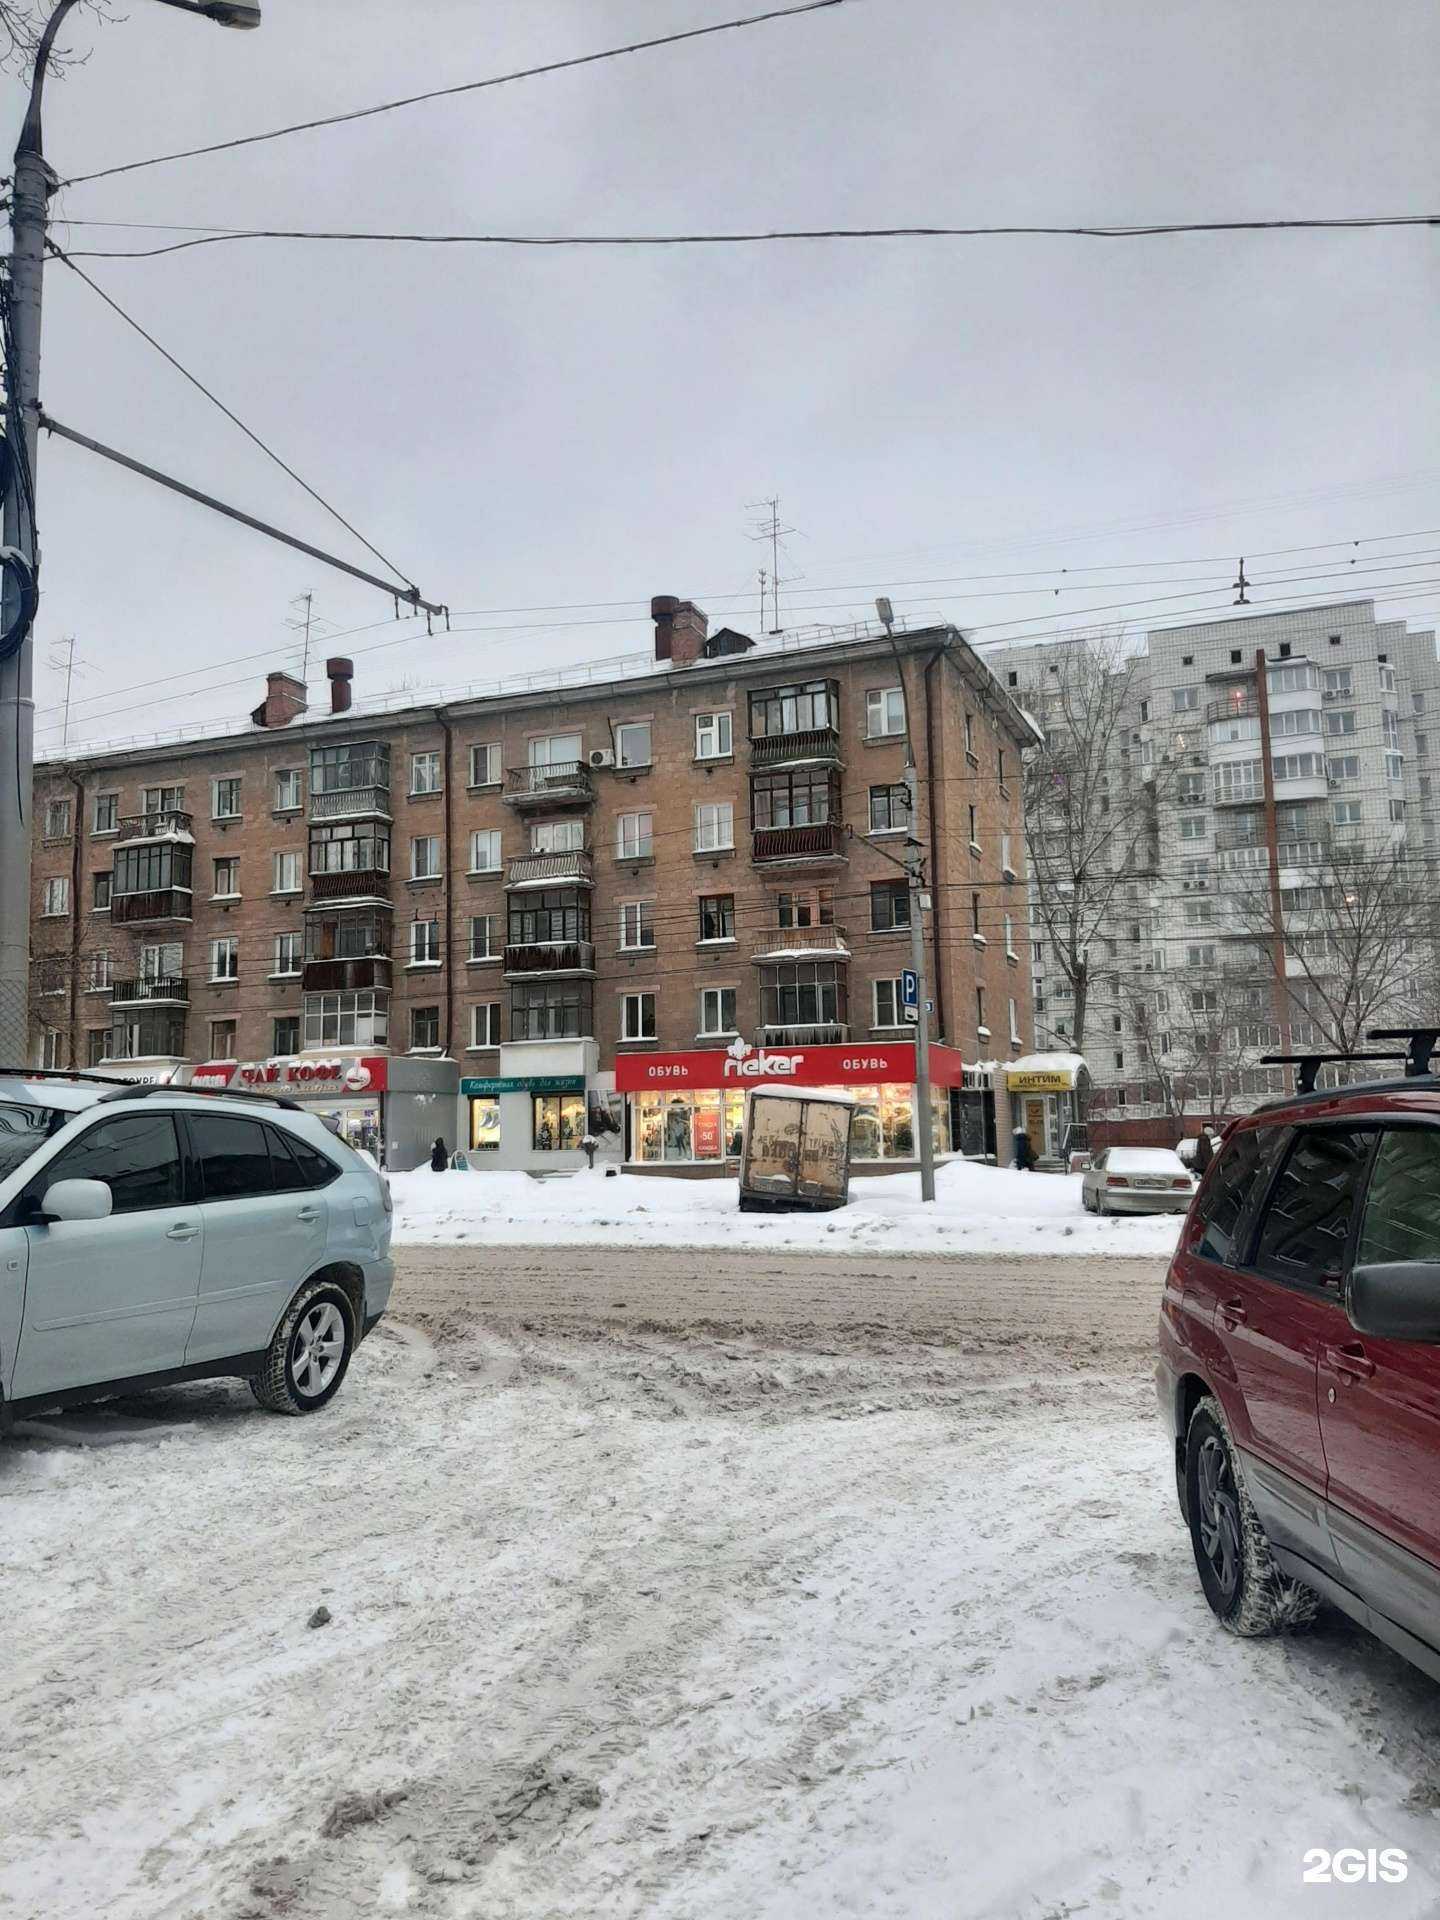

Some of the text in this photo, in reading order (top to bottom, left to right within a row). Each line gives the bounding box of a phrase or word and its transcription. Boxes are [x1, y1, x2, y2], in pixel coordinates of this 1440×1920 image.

[906, 974, 915, 1002] P
[648, 1066, 689, 1077] ОБУВЬ
[724, 1049, 804, 1077] rieker
[843, 1058, 888, 1070] ОБУВЬ
[241, 1062, 280, 1083] ЧАЙ
[287, 1061, 342, 1082] КОФЕ
[1018, 1075, 1062, 1084] ИНТИМ
